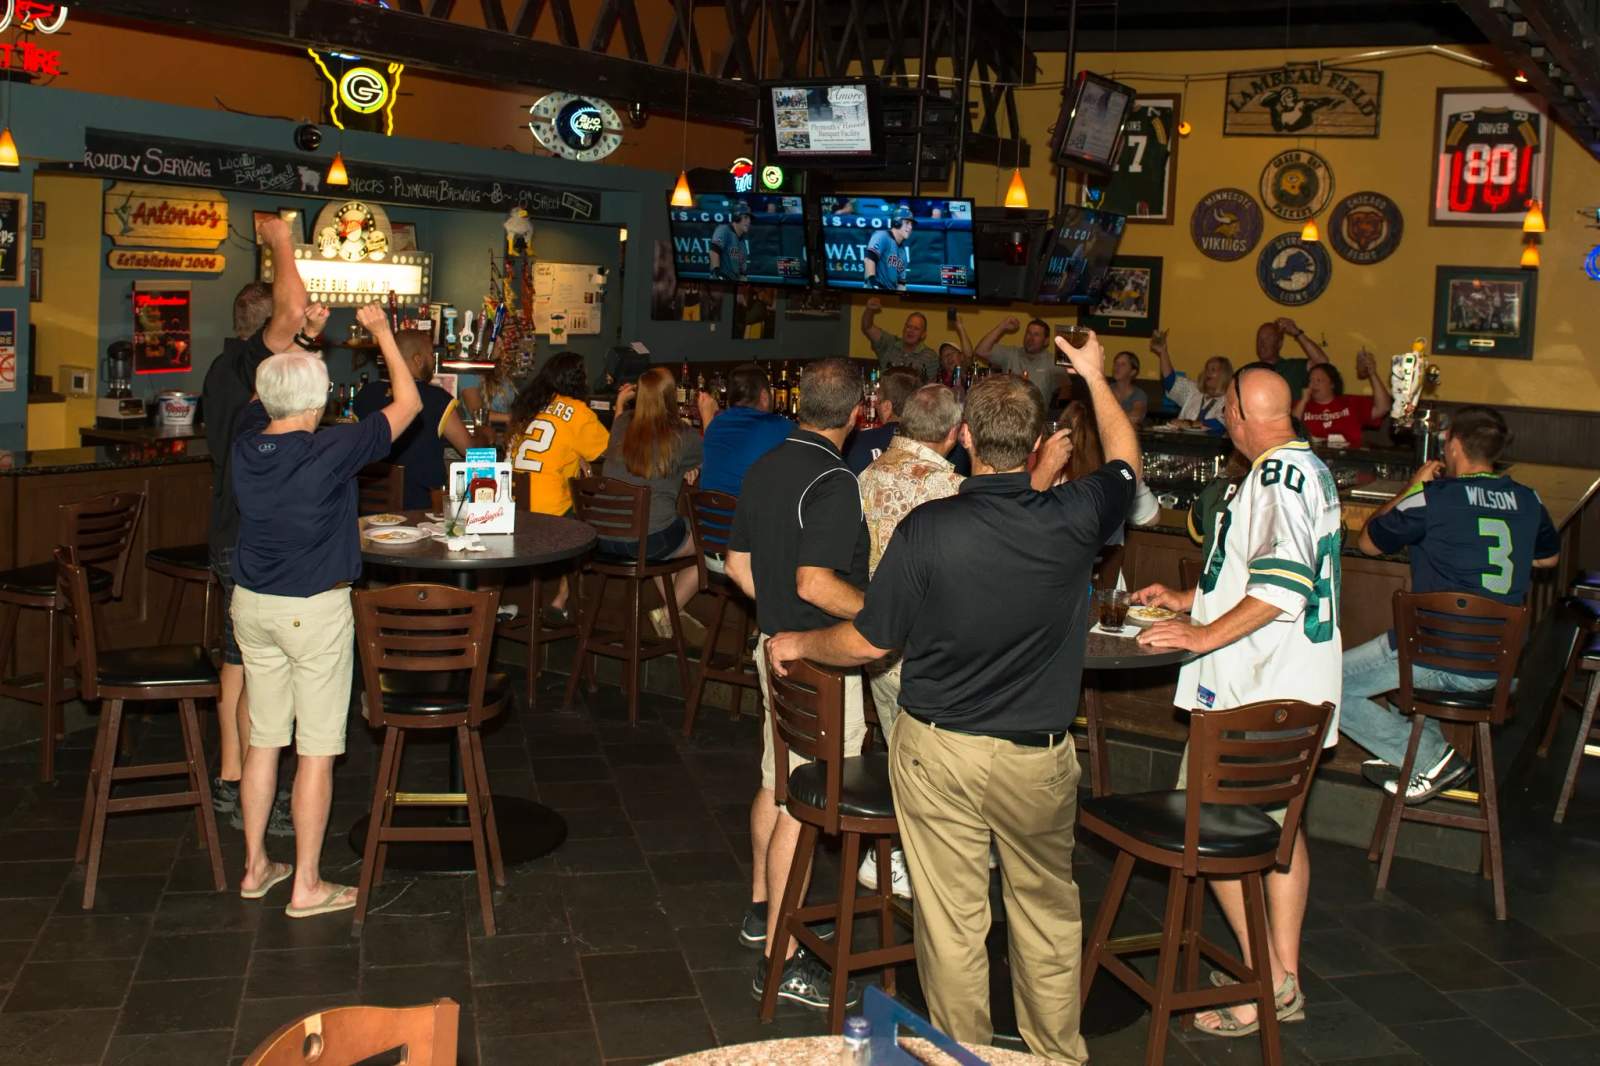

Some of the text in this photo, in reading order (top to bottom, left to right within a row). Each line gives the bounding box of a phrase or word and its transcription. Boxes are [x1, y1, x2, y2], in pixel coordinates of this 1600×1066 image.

[16, 40, 62, 76] TIRE
[1230, 69, 1376, 116] LAMBEAU FIELD
[1478, 123, 1509, 134] DRIVER
[84, 147, 212, 177] ROUDLY SERVING
[1464, 143, 1518, 184] 80
[131, 201, 219, 229] Antonio's
[674, 237, 712, 253] WAT
[825, 243, 867, 262] WAT
[1201, 236, 1248, 252] VIKINGS
[117, 253, 184, 268] Established
[356, 279, 376, 292] JULY
[544, 402, 574, 422] ERS
[514, 419, 557, 472] 2
[1260, 458, 1306, 494] 80
[1465, 485, 1518, 511] WILSON
[1478, 517, 1515, 595] 3
